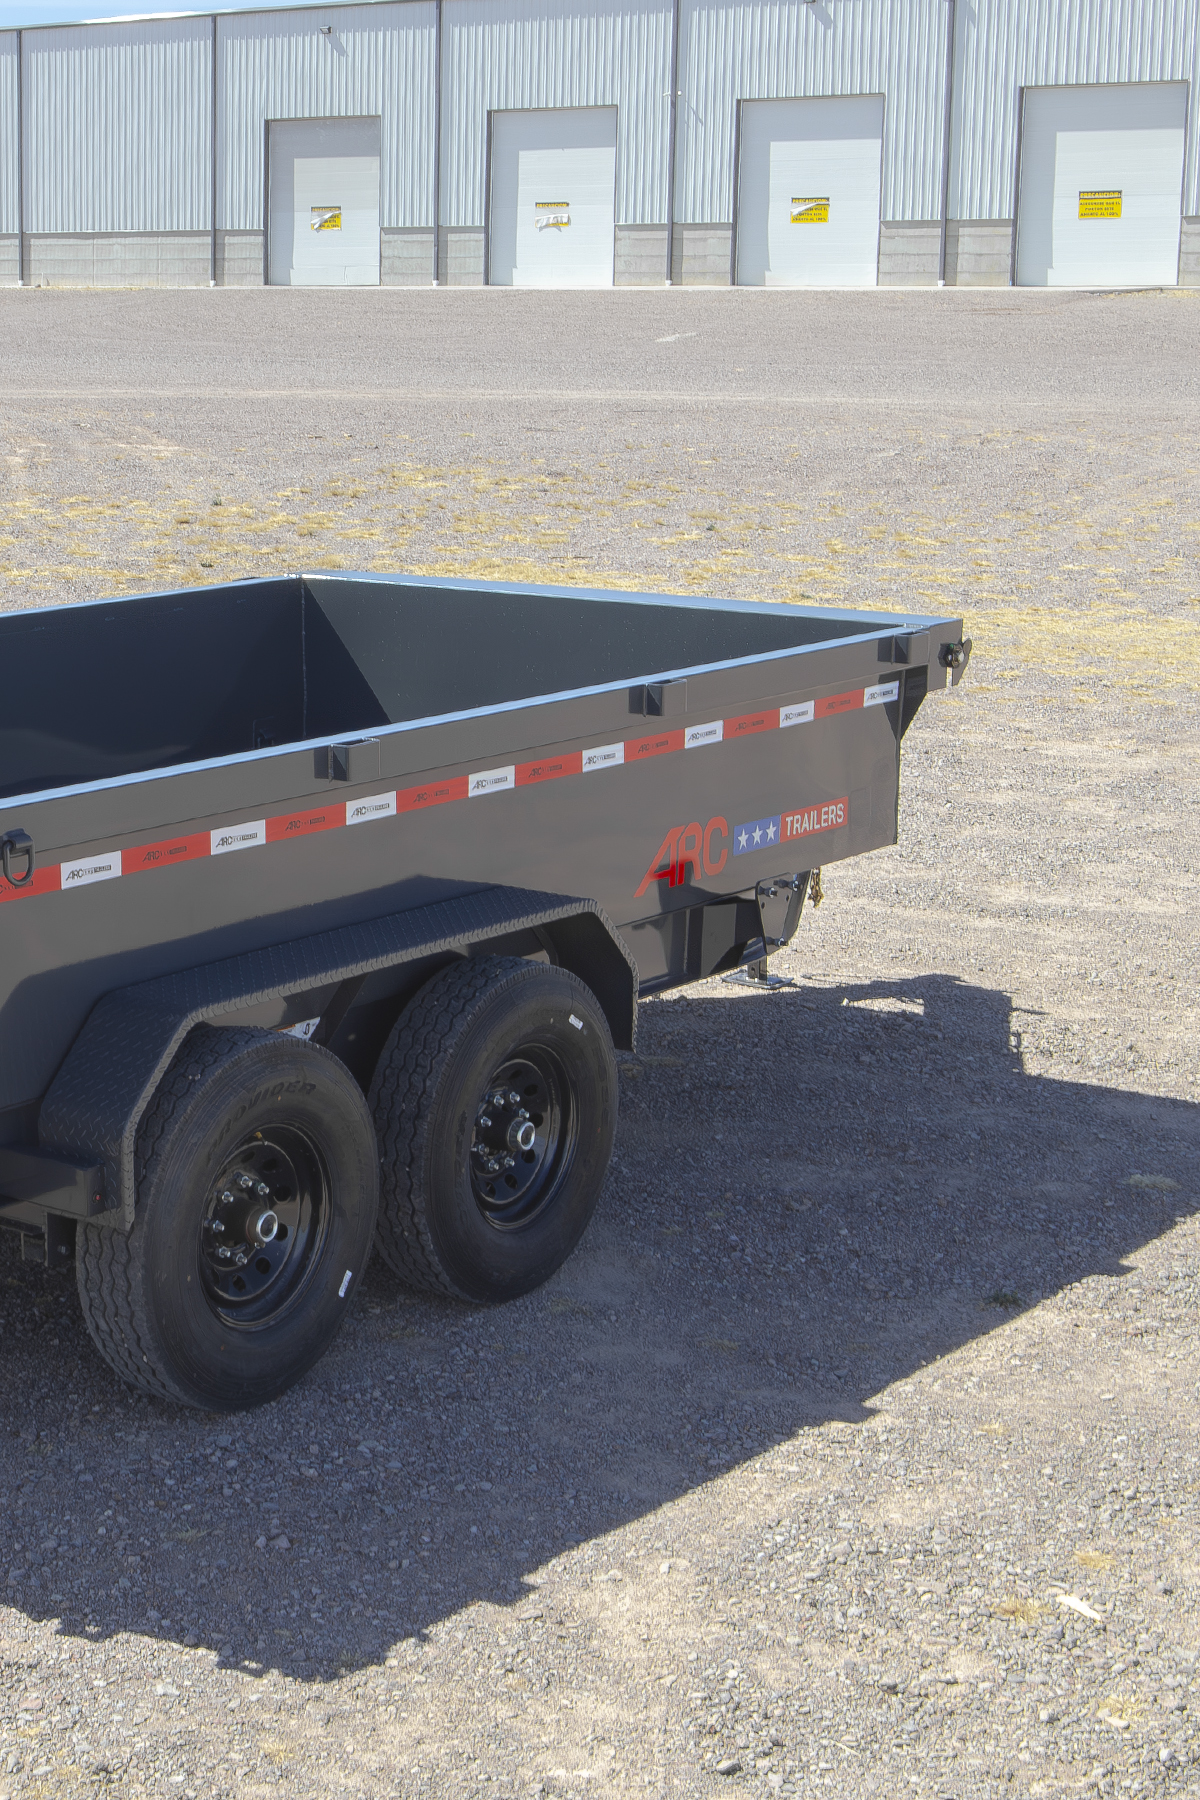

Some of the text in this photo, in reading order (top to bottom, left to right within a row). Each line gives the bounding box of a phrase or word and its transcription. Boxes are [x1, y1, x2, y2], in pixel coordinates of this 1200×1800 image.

[472, 779, 487, 790] ARC
[351, 805, 367, 817] ARC
[216, 836, 233, 848] ARC
[142, 850, 160, 862] ARC
[633, 803, 844, 898] ARC TRAILERS
[65, 868, 84, 881] ARC
